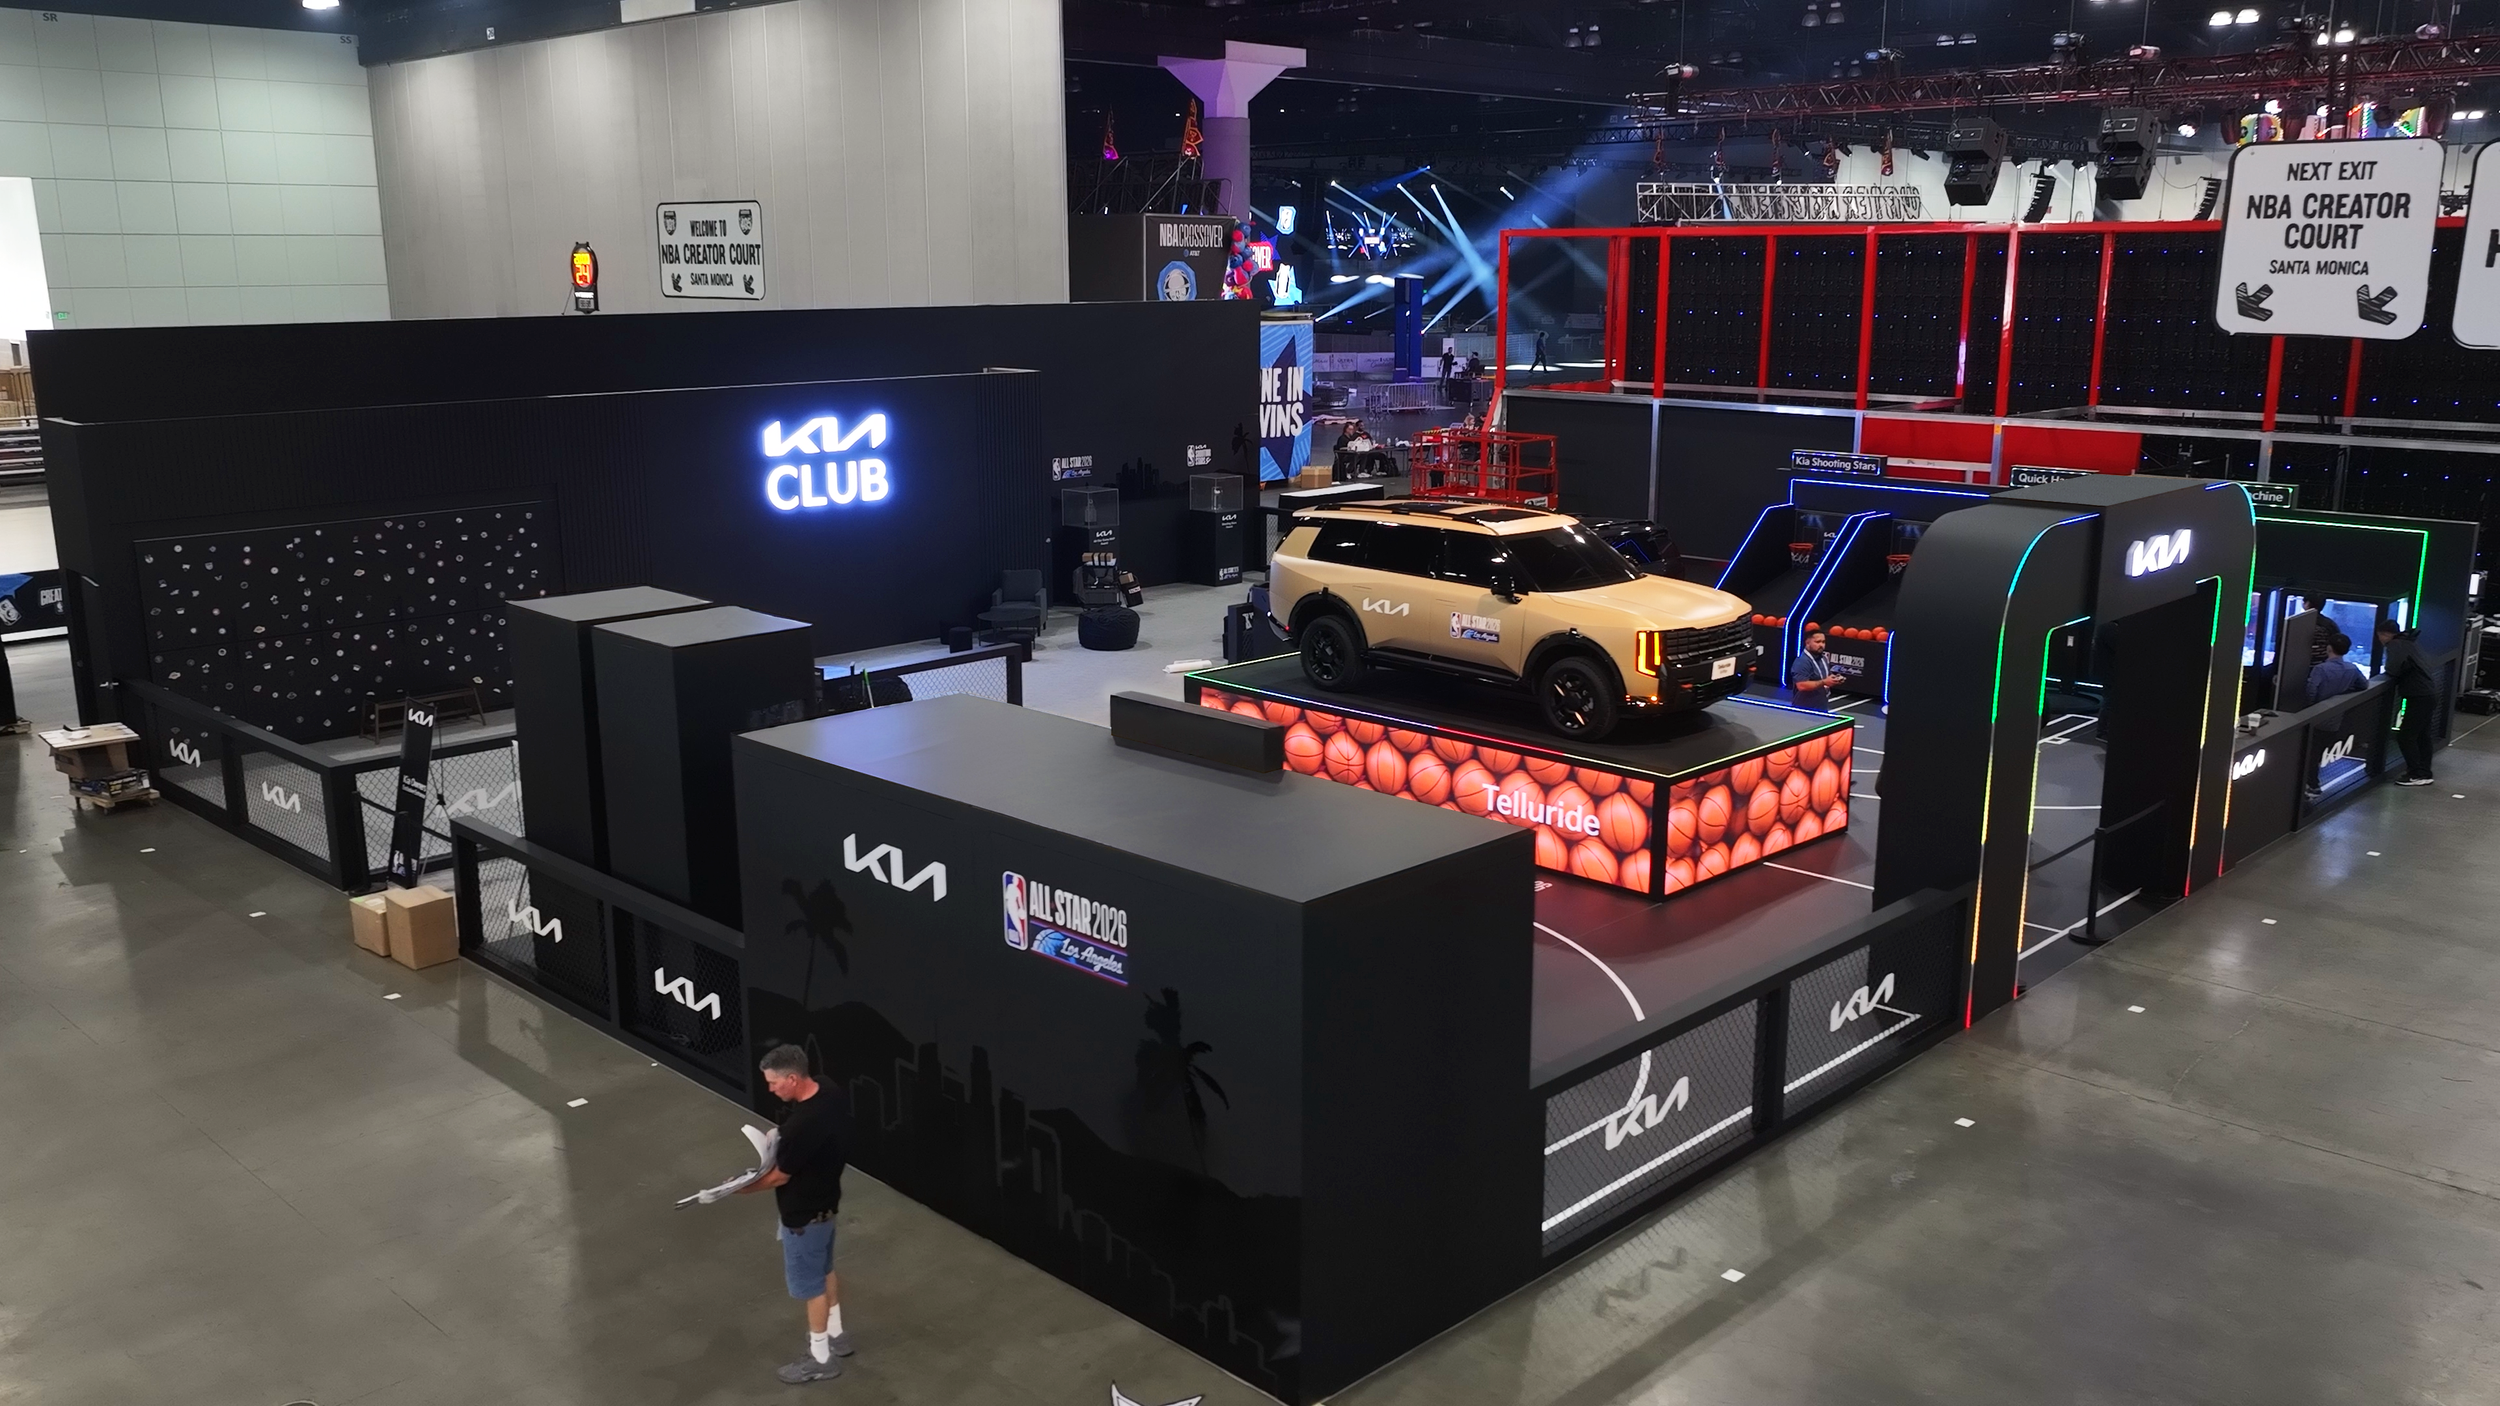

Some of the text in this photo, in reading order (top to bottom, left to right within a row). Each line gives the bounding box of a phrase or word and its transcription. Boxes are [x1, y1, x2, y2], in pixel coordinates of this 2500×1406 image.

[42, 12, 58, 22] SR
[340, 36, 352, 44] SS
[2287, 161, 2378, 181] NEXT EXIT
[2246, 192, 2412, 219] NBA CREATOR
[690, 219, 718, 237] WELCOME
[719, 219, 727, 237] TO
[2284, 223, 2363, 249] COURT
[661, 243, 761, 265] NBA CREATOR COURT
[2269, 260, 2369, 276] SANTA MONICA
[690, 273, 734, 287] SANTA MONICA
[1260, 367, 1282, 403] NE
[1287, 367, 1304, 402] IN
[763, 413, 887, 457] KIA
[1796, 456, 1876, 471] Kia Shooting Stars
[2018, 473, 2048, 484] Quick
[766, 458, 889, 511] CLUB
[2249, 486, 2284, 502] chine
[2126, 529, 2191, 577] KIA
[1362, 597, 1409, 617] KIA
[1462, 614, 1500, 632] ALL STAR 2026
[1840, 655, 1852, 665] STAR
[408, 708, 434, 727] KIA
[169, 738, 200, 768] KIA
[2232, 749, 2265, 780] KIA
[2320, 735, 2354, 767] KIA
[262, 781, 300, 813] KIA
[1482, 783, 1600, 836] Telluride
[843, 833, 947, 902] KIA
[508, 898, 562, 943] KIA
[1029, 881, 1127, 948] ALL STAR 2026
[1060, 937, 1123, 974] Los Angeles
[655, 967, 721, 1020] KIA
[1830, 973, 1894, 1032] KIA
[1605, 1076, 1688, 1150] KIA
